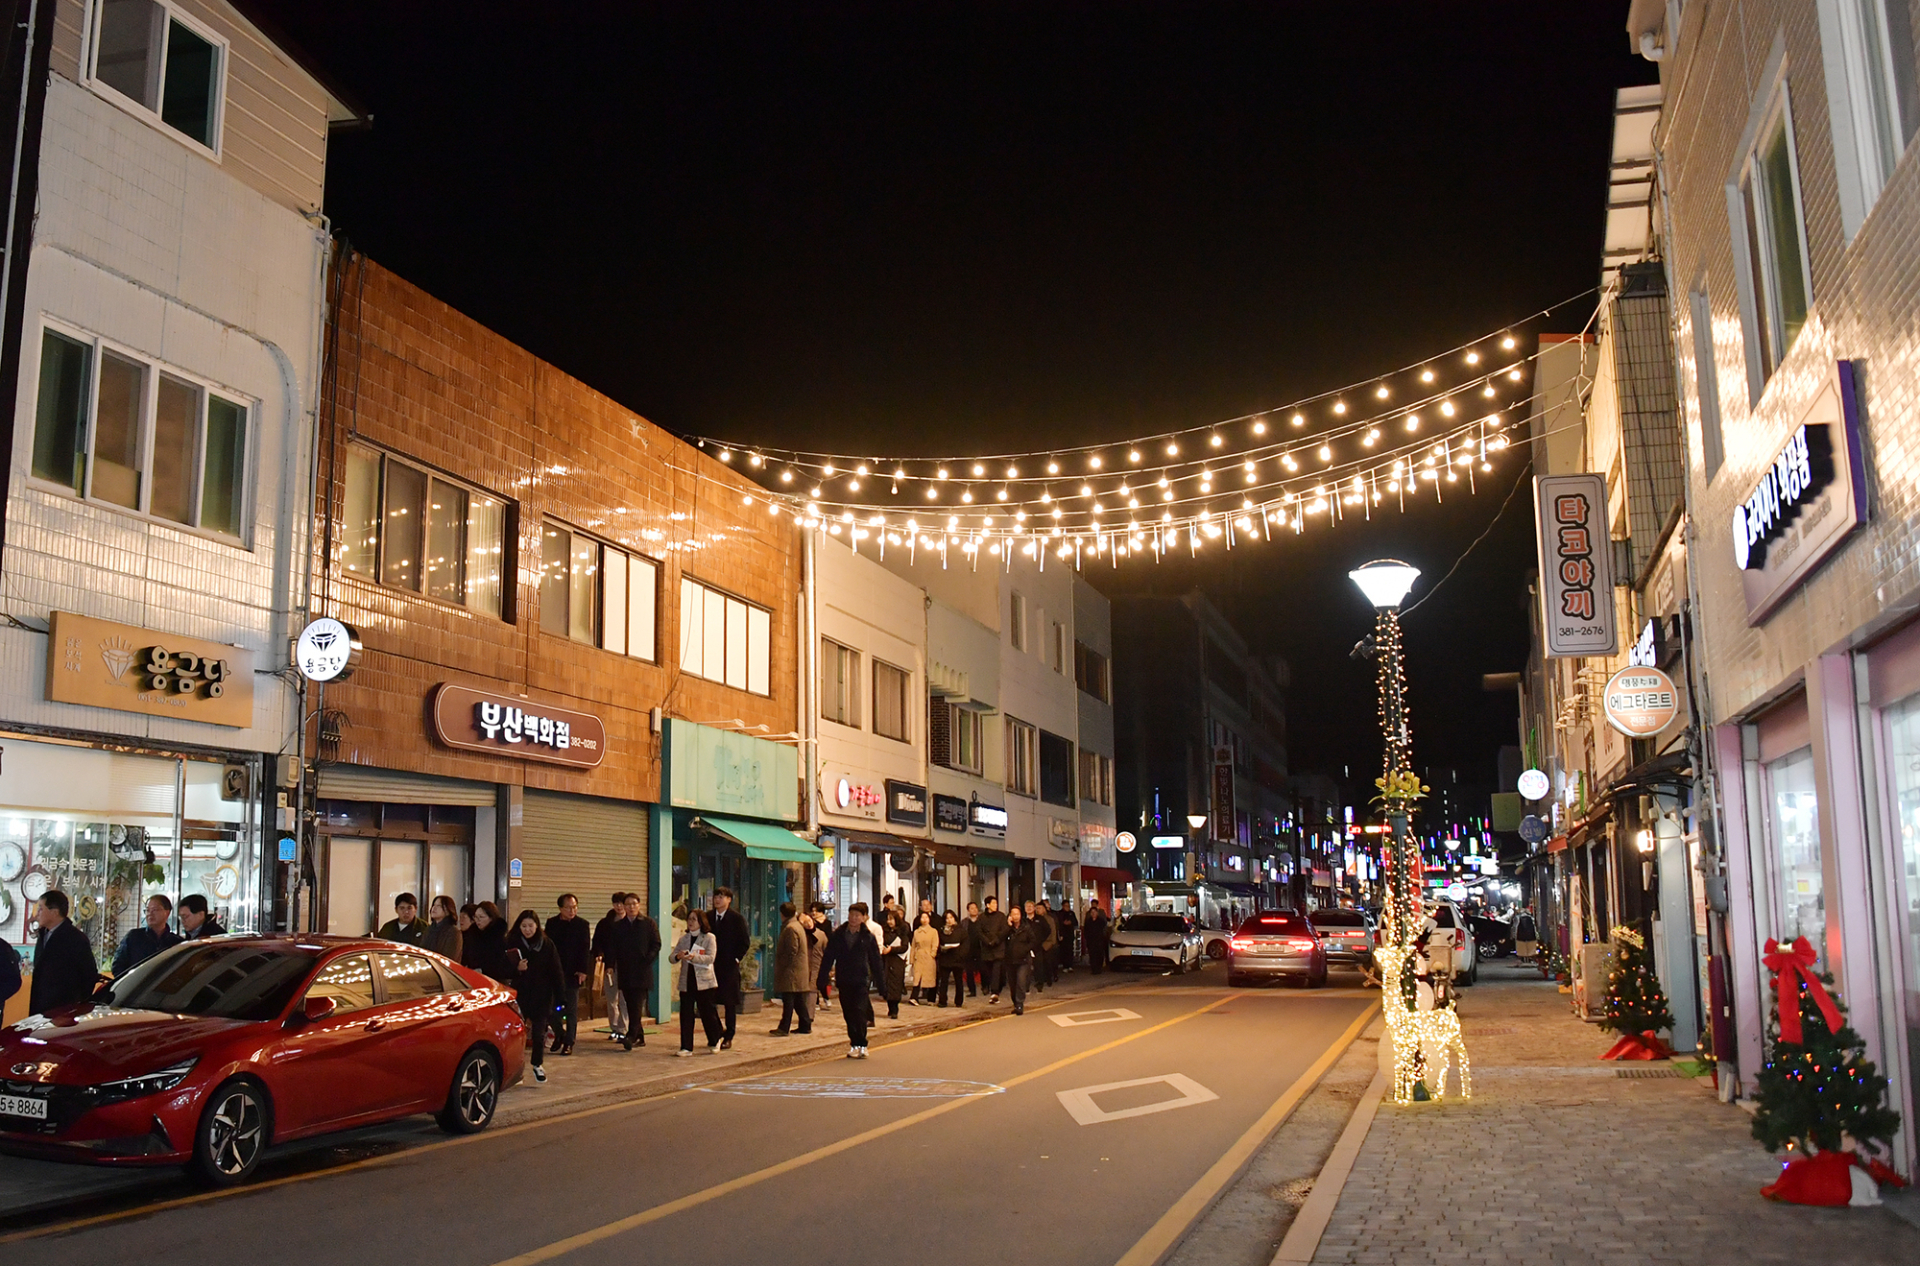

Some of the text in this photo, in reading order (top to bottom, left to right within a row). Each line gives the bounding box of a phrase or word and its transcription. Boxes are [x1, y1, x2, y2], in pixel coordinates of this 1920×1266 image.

[1555, 493, 1596, 621] 타코야끼
[1558, 626, 1604, 637] 381-2676
[146, 644, 232, 699] 용금당
[305, 656, 342, 674] 용금당
[1610, 692, 1672, 710] 에그타르트
[480, 701, 570, 749] 부산백화점
[1630, 716, 1656, 727] 전문점
[570, 736, 597, 750] 382-0202
[17, 1099, 44, 1116] 8864
